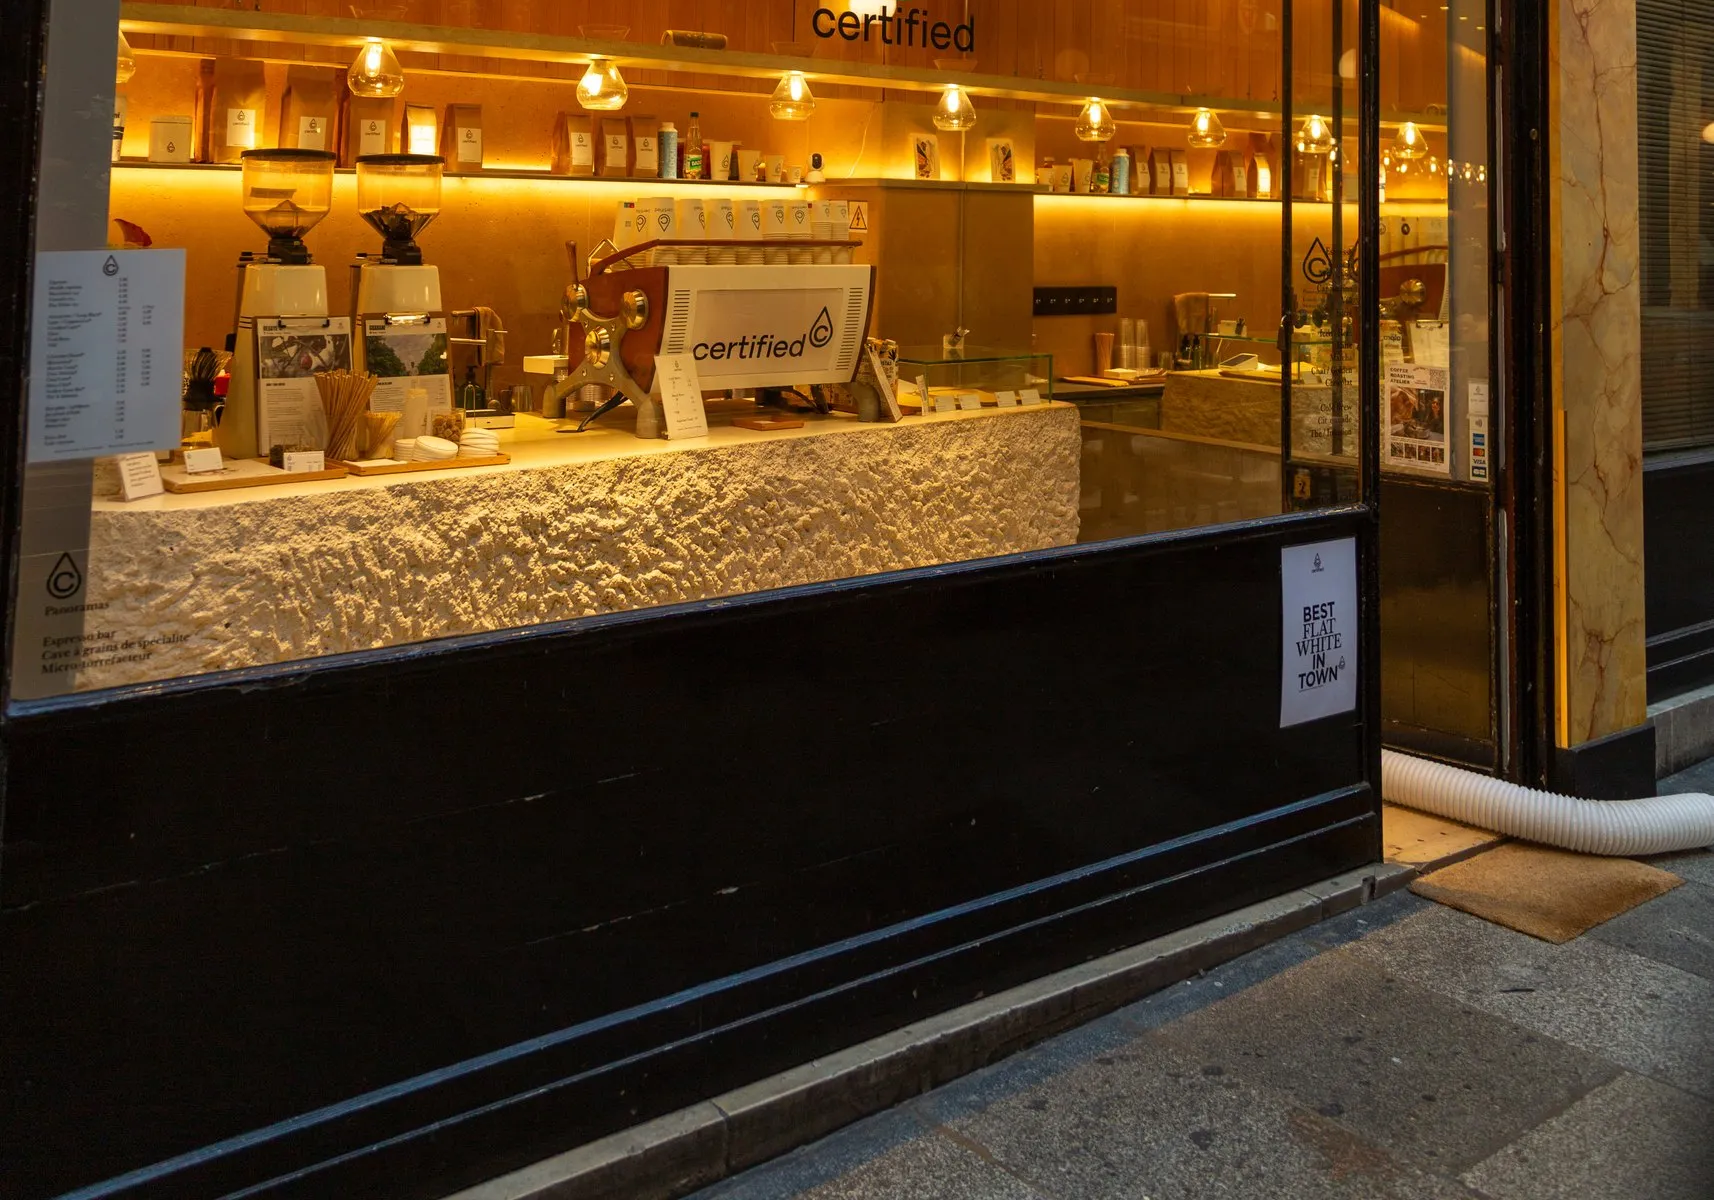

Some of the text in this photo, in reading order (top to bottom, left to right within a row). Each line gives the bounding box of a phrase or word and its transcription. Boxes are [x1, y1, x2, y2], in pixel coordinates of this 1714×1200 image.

[812, 5, 975, 52] certified
[693, 334, 806, 361] certified
[44, 601, 110, 616] Panoramas
[1303, 601, 1335, 623] BEST
[42, 629, 117, 649] Espresso bar
[1302, 618, 1336, 639] FLAT
[41, 649, 71, 661] Cave
[82, 643, 118, 657] grains
[120, 640, 138, 650] de
[1295, 633, 1342, 657] WHITE
[1312, 651, 1326, 670] IN
[1298, 665, 1338, 689] TOWN
